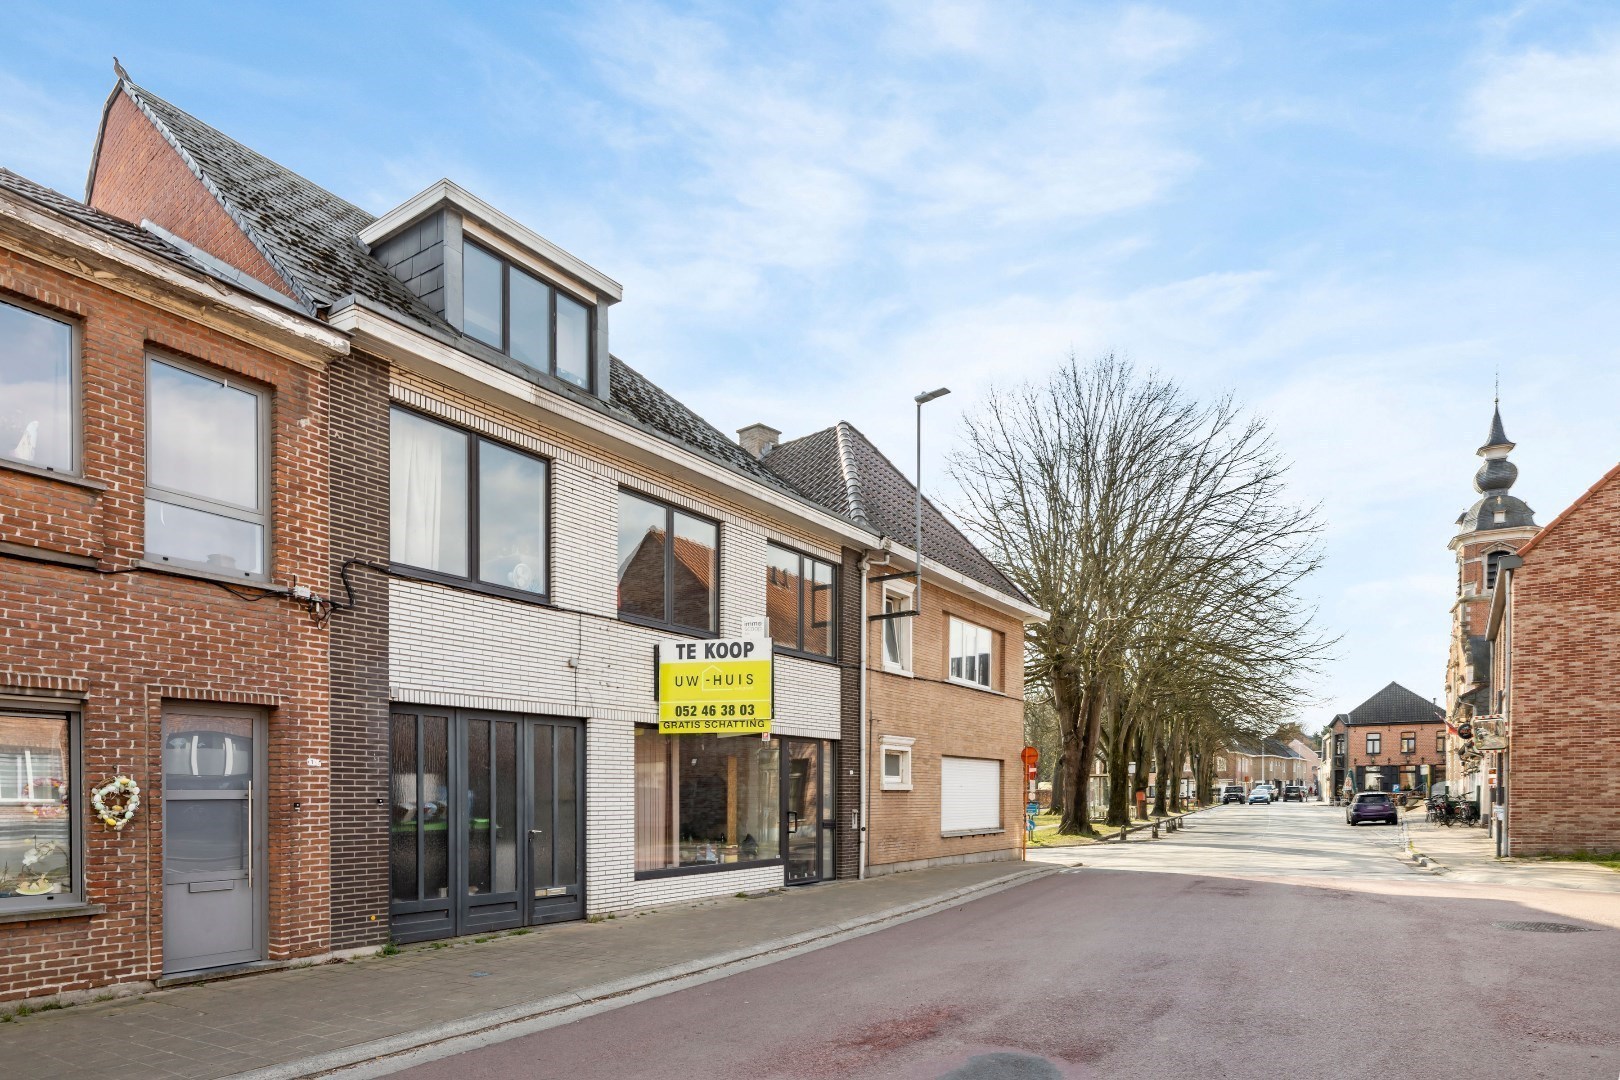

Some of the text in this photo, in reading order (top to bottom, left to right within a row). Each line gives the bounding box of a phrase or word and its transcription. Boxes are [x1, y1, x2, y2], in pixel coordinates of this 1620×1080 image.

[675, 641, 755, 660] TE KOOP
[675, 703, 755, 717] 052 46 38 03
[663, 719, 765, 729] GRATIS SCHATTING
